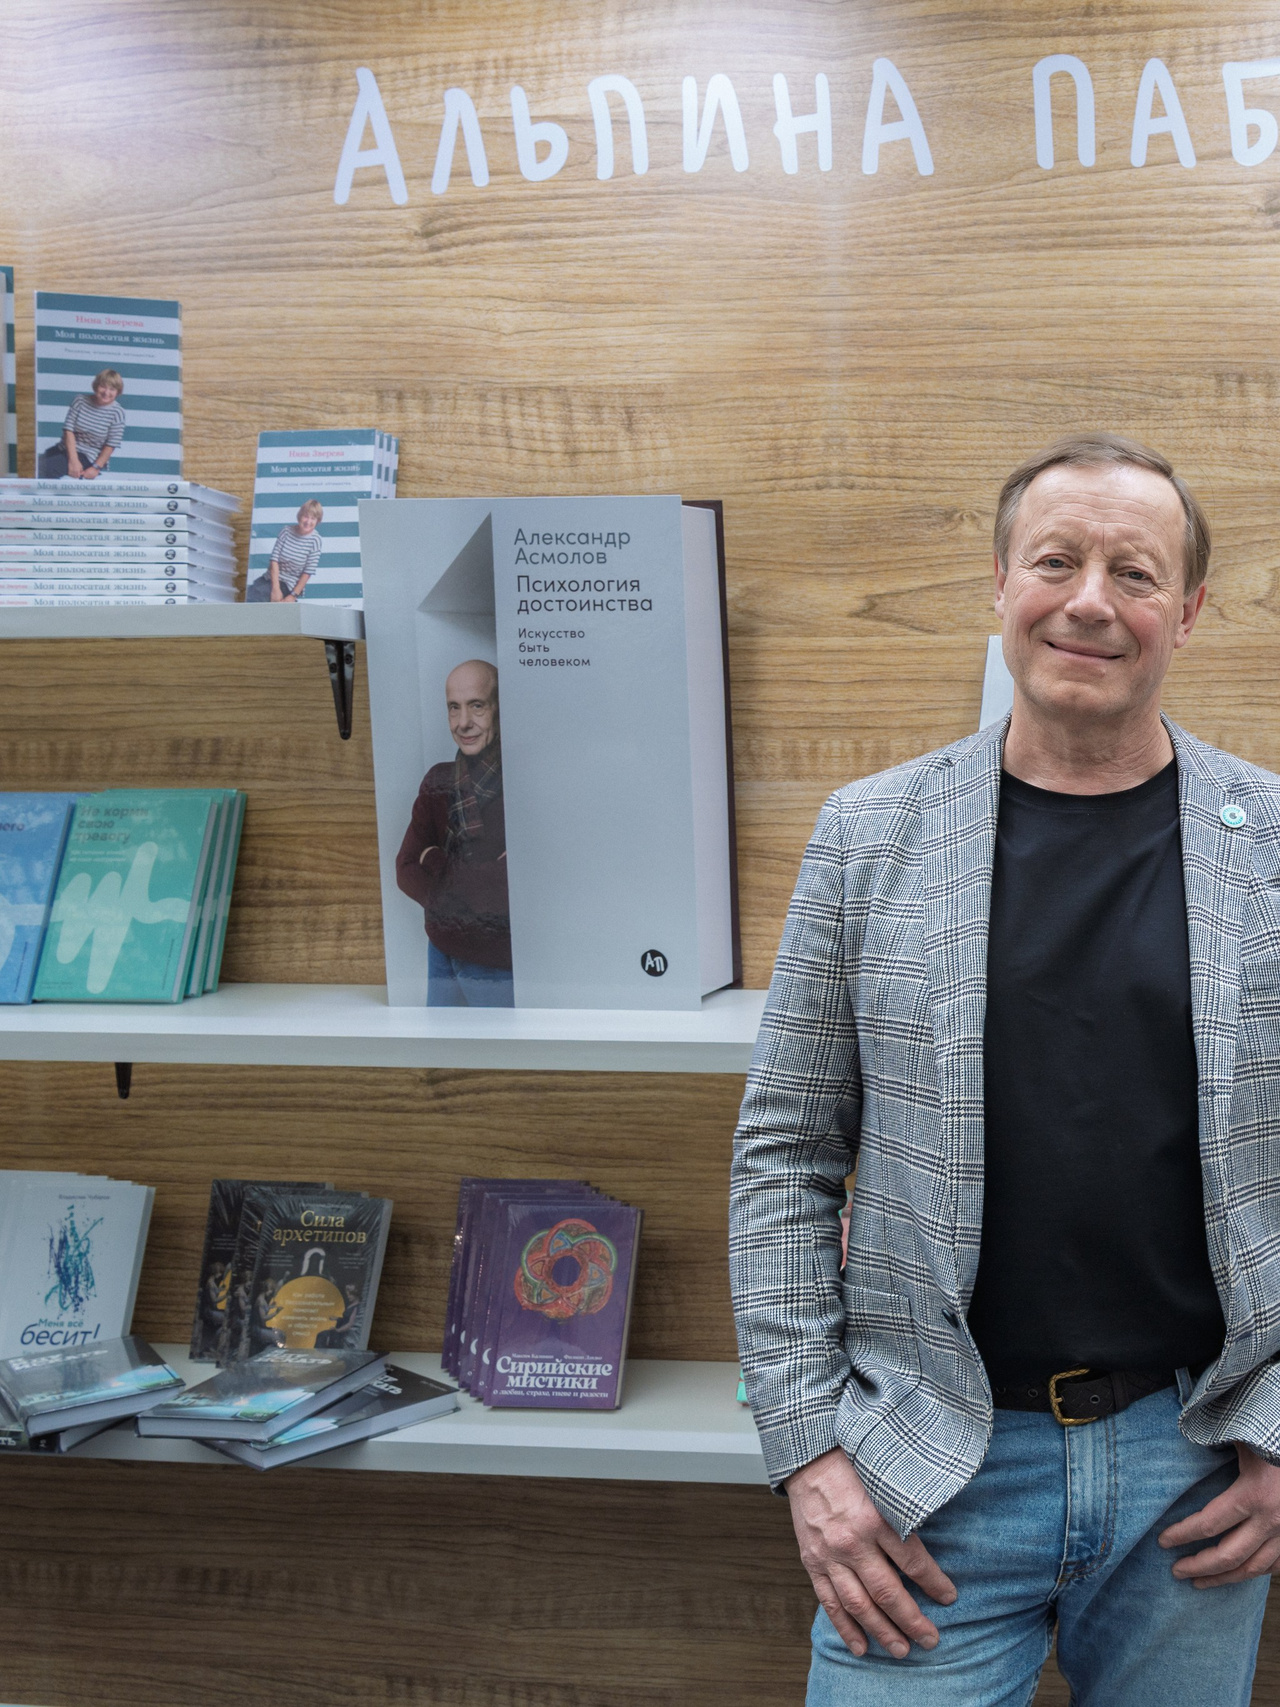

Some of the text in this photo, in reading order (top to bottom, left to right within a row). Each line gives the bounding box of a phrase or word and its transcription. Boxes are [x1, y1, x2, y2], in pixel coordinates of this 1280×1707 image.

[333, 57, 934, 205] АЛЬПИНА
[75, 315, 144, 327] Нина Зверева
[55, 330, 165, 345] Моя полосатая жизнь
[312, 450, 345, 458] Зверева
[290, 465, 332, 473] полосатая
[334, 464, 360, 472] жизнь
[37, 482, 149, 492] Моя полосатая жизнь
[32, 498, 148, 509] Моя полосатая жизнь
[31, 515, 145, 525] Моя полосатая жизнь
[33, 533, 147, 542] Моя полосатая жизнь
[514, 528, 631, 550] Александр
[33, 549, 147, 558] Моя полосатая жизнь
[514, 547, 607, 565] Асмолов
[32, 565, 147, 575] Моя полосатая жизнь
[517, 575, 641, 593] Психология
[517, 599, 653, 615] достоинства
[518, 628, 586, 642] Искусство
[519, 642, 550, 653] быть
[519, 658, 591, 667] человеком
[300, 1210, 345, 1228] Сила
[272, 1228, 368, 1246] архетипов
[38, 1318, 64, 1328] Меня
[20, 1322, 101, 1346] бесит!
[496, 1355, 613, 1379] Сирийские
[506, 1375, 598, 1390] мистики
